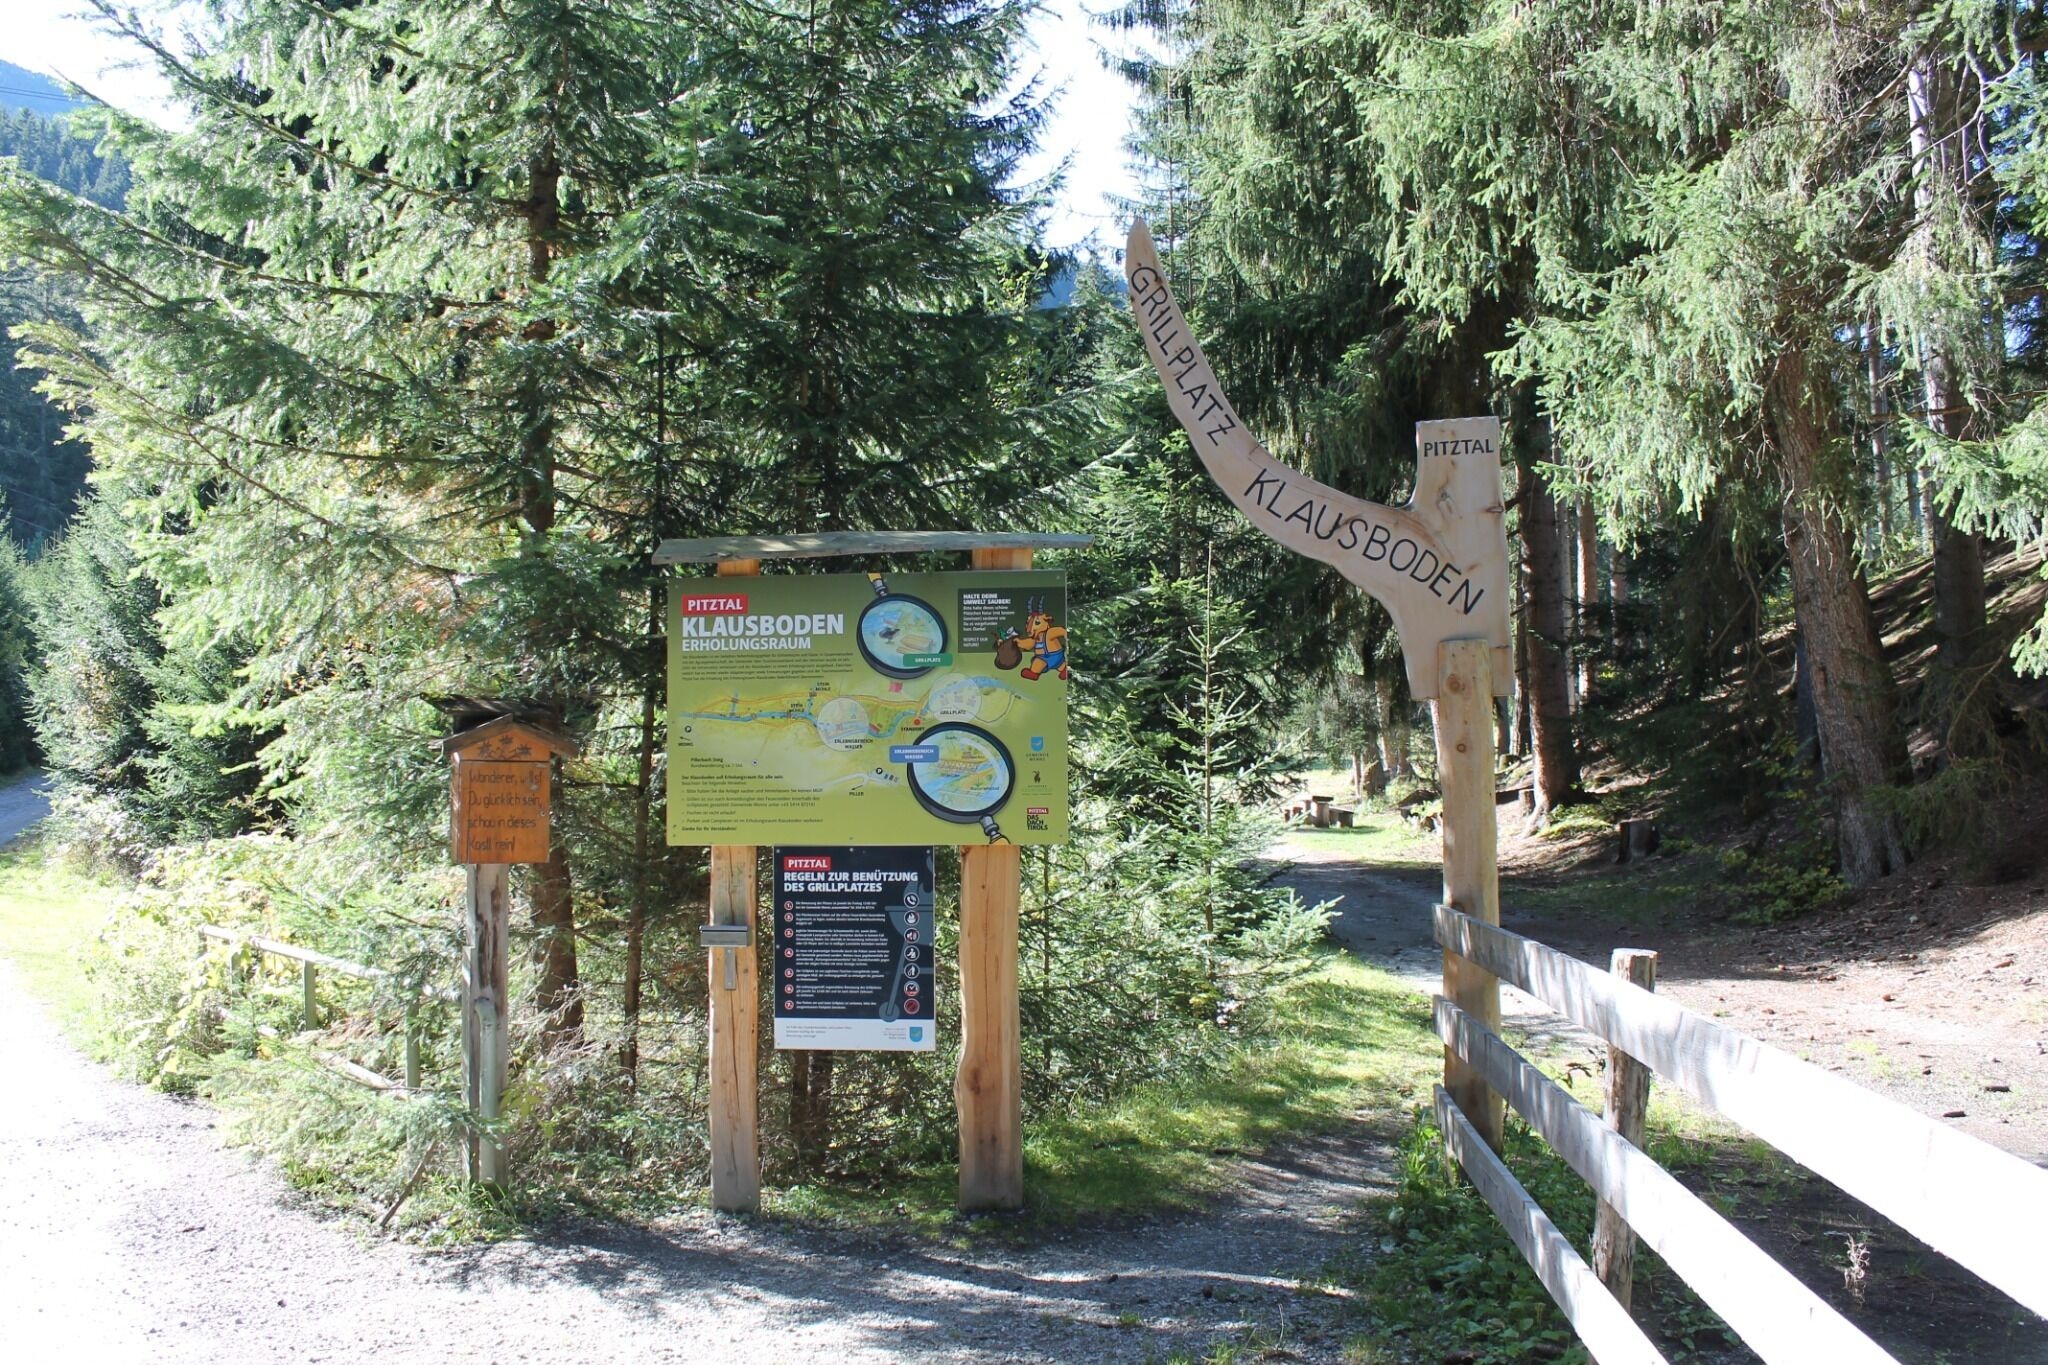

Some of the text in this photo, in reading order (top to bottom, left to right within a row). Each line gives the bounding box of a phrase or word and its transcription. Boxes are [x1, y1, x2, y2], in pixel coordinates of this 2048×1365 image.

[1131, 266, 1236, 447] GRILLPLATZ
[1423, 438, 1495, 458] PITZTAL
[1244, 468, 1485, 615] KLAUSBODEN
[687, 599, 744, 611] PITZTAL
[682, 614, 844, 637] KLAUSBODEN
[682, 637, 811, 651] ERHOLUNGSRAUM
[469, 769, 517, 785] Wanderer,
[469, 790, 482, 806] Du
[483, 792, 521, 808] glücklich
[468, 815, 537, 828] schau in dieses
[788, 859, 829, 868] PITZTAL
[784, 869, 919, 882] REGELN ZUR BENÜTZUNG
[784, 882, 883, 893] DES GRILLPLATZES
